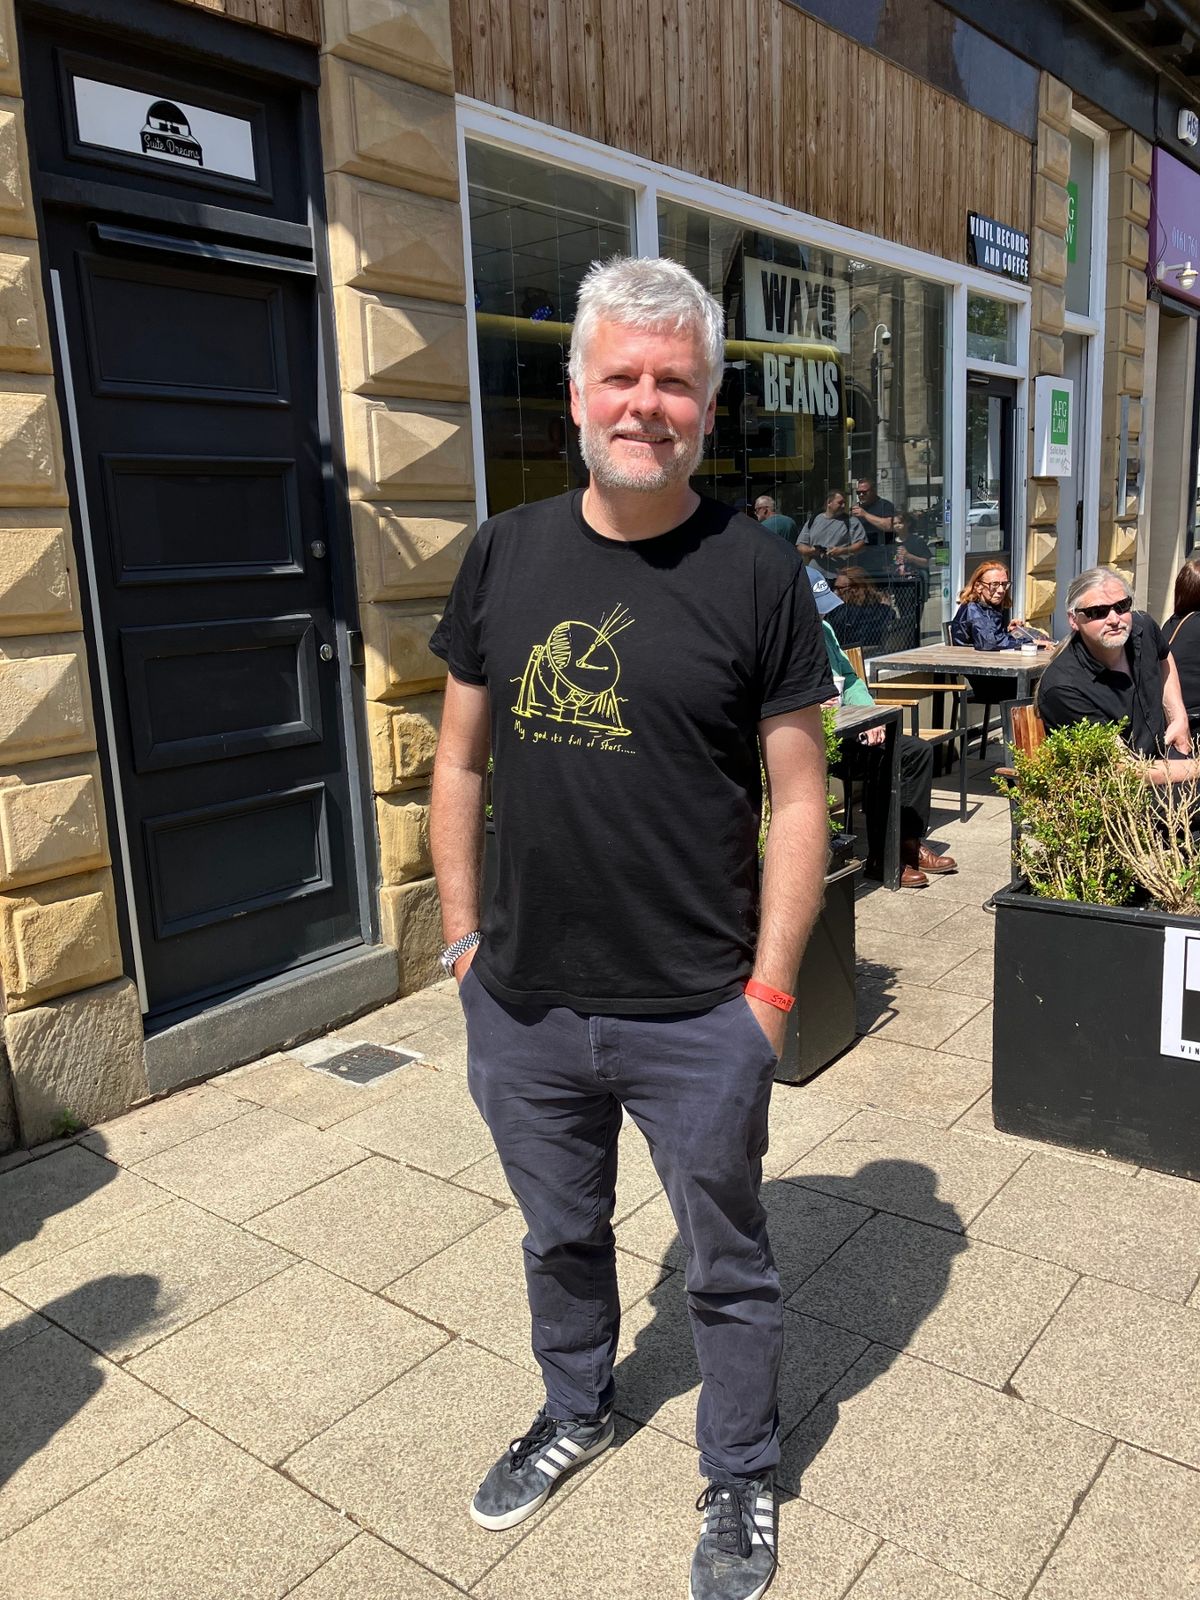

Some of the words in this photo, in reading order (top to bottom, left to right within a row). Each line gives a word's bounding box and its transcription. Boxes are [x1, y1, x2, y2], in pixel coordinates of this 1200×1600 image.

[144, 134, 165, 151] Suite
[166, 139, 200, 159] Dreams
[970, 215, 994, 242] VINYL
[996, 226, 1029, 256] RECORDS
[984, 245, 1000, 267] AND
[1002, 252, 1029, 277] COFFEE
[761, 270, 823, 340] WAX
[763, 352, 839, 417] BEANS
[1053, 399, 1067, 418] AFG
[1052, 417, 1067, 434] LAW
[514, 720, 525, 740] My
[568, 735, 582, 746] full
[587, 739, 595, 748] of
